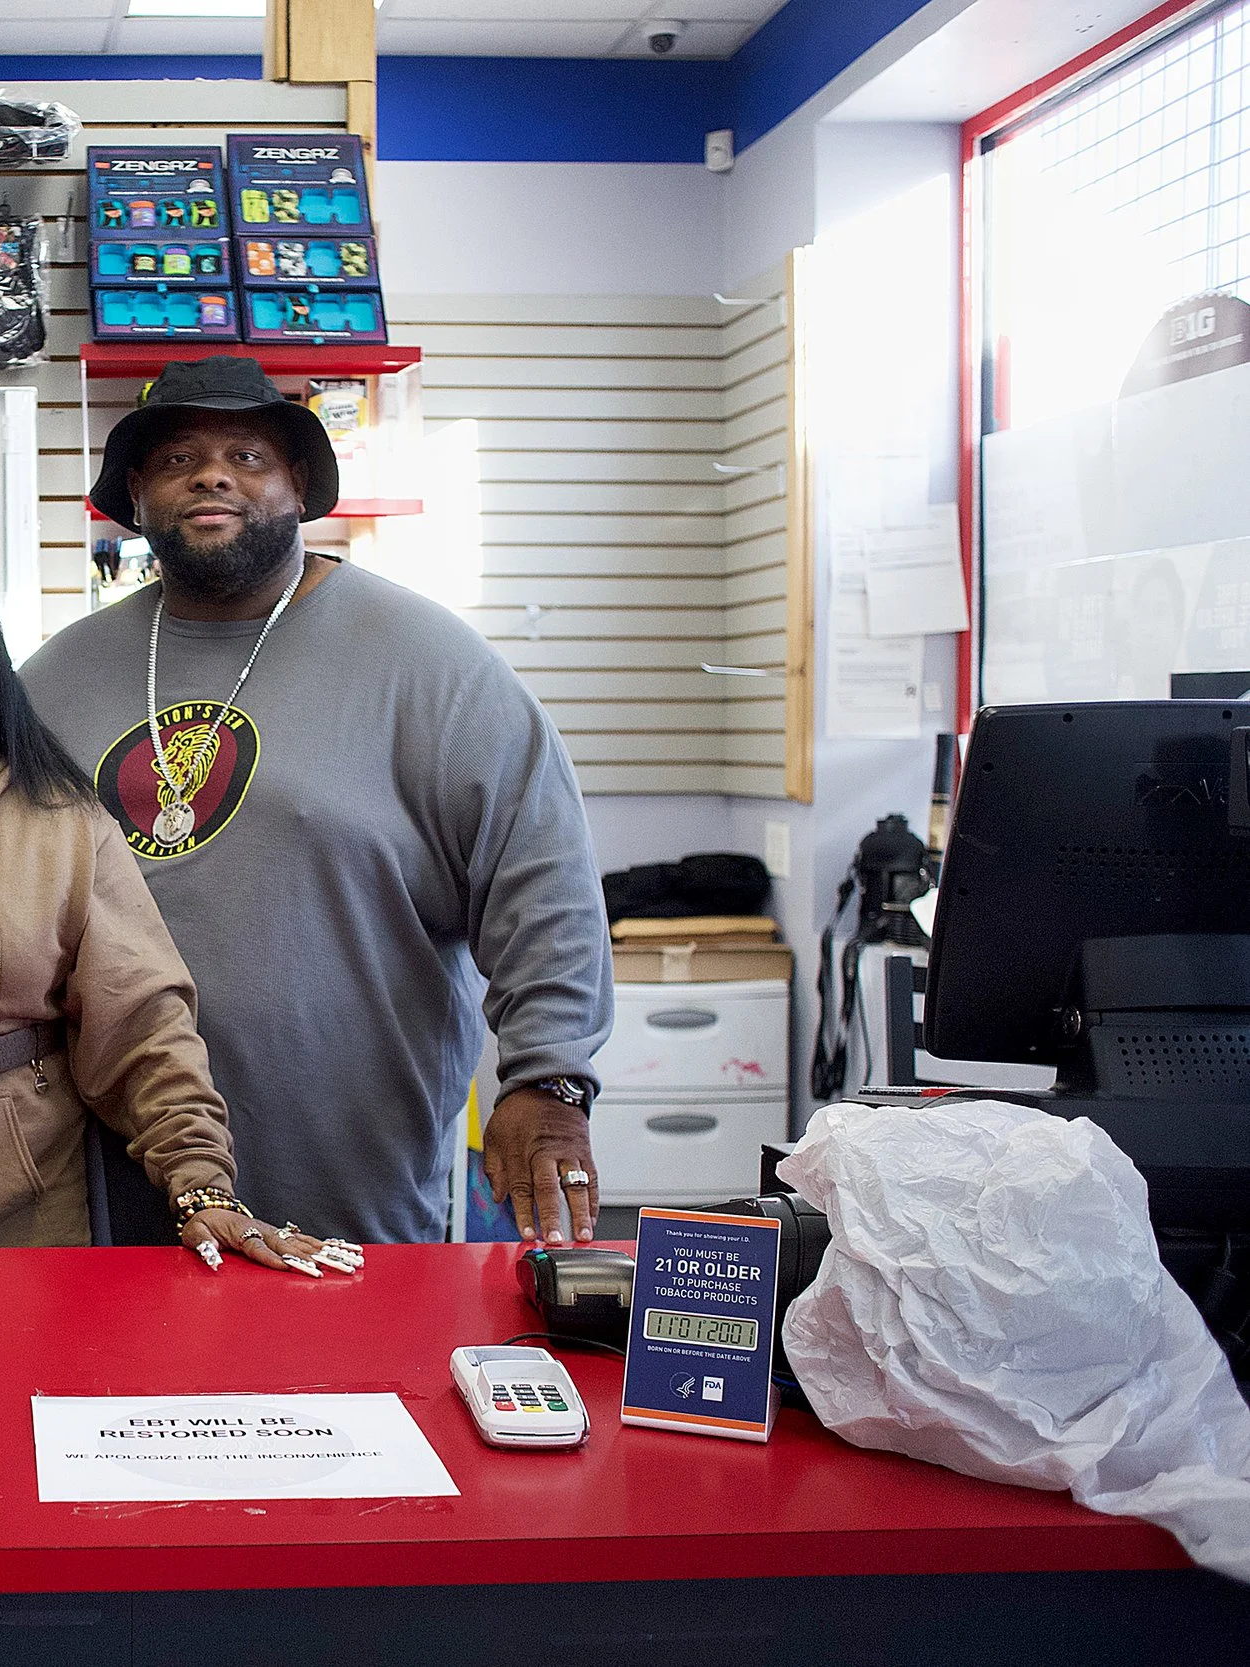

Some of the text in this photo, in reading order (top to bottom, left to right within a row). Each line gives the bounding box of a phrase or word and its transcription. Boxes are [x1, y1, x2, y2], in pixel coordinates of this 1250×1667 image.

[252, 147, 339, 159] ZENGAZ
[111, 160, 199, 172] ZENGAZ
[703, 1233, 726, 1241] showing
[673, 1247, 740, 1262] YOU MUST BE
[655, 1258, 761, 1281] 21 OR OLDER
[672, 1276, 742, 1292] TO PURCHASE
[654, 1286, 758, 1305] TOBACCO PRODUCTS
[682, 1349, 703, 1357] BEFORE
[704, 1351, 715, 1359] THE
[732, 1354, 751, 1362] ABOVE
[705, 1381, 721, 1390] FDA
[129, 1417, 296, 1427] EBT WILL BE
[100, 1428, 333, 1438] RESTORED SOON
[258, 1451, 384, 1460] INCONVENIENCE
